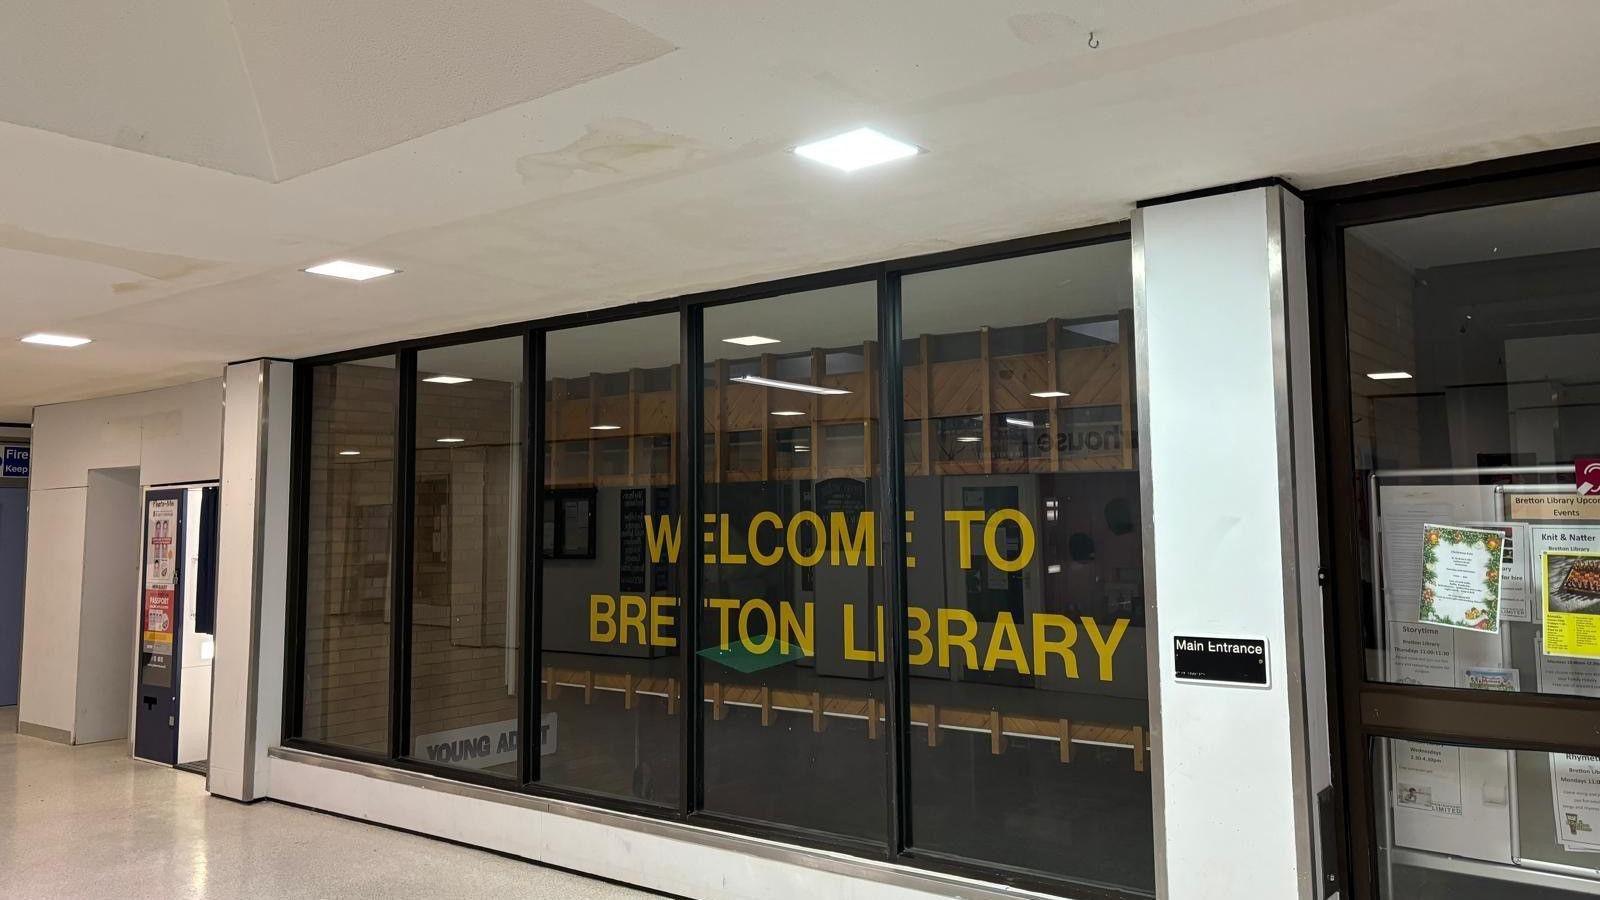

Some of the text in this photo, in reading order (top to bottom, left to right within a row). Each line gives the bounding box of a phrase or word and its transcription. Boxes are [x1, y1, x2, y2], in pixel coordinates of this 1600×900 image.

[6, 449, 29, 460] Fire
[5, 464, 28, 475] Keep
[1547, 497, 1575, 506] Library
[1553, 509, 1580, 517] Events
[944, 509, 1036, 571] TO
[1541, 533, 1596, 542] Knit & Natter
[1402, 625, 1439, 636] Storytime
[589, 594, 1131, 682] BRETON LIBRARY
[1176, 639, 1262, 655] Main Entrance
[426, 724, 550, 763] YOUNG ADT
[1560, 776, 1587, 784] Mondays
